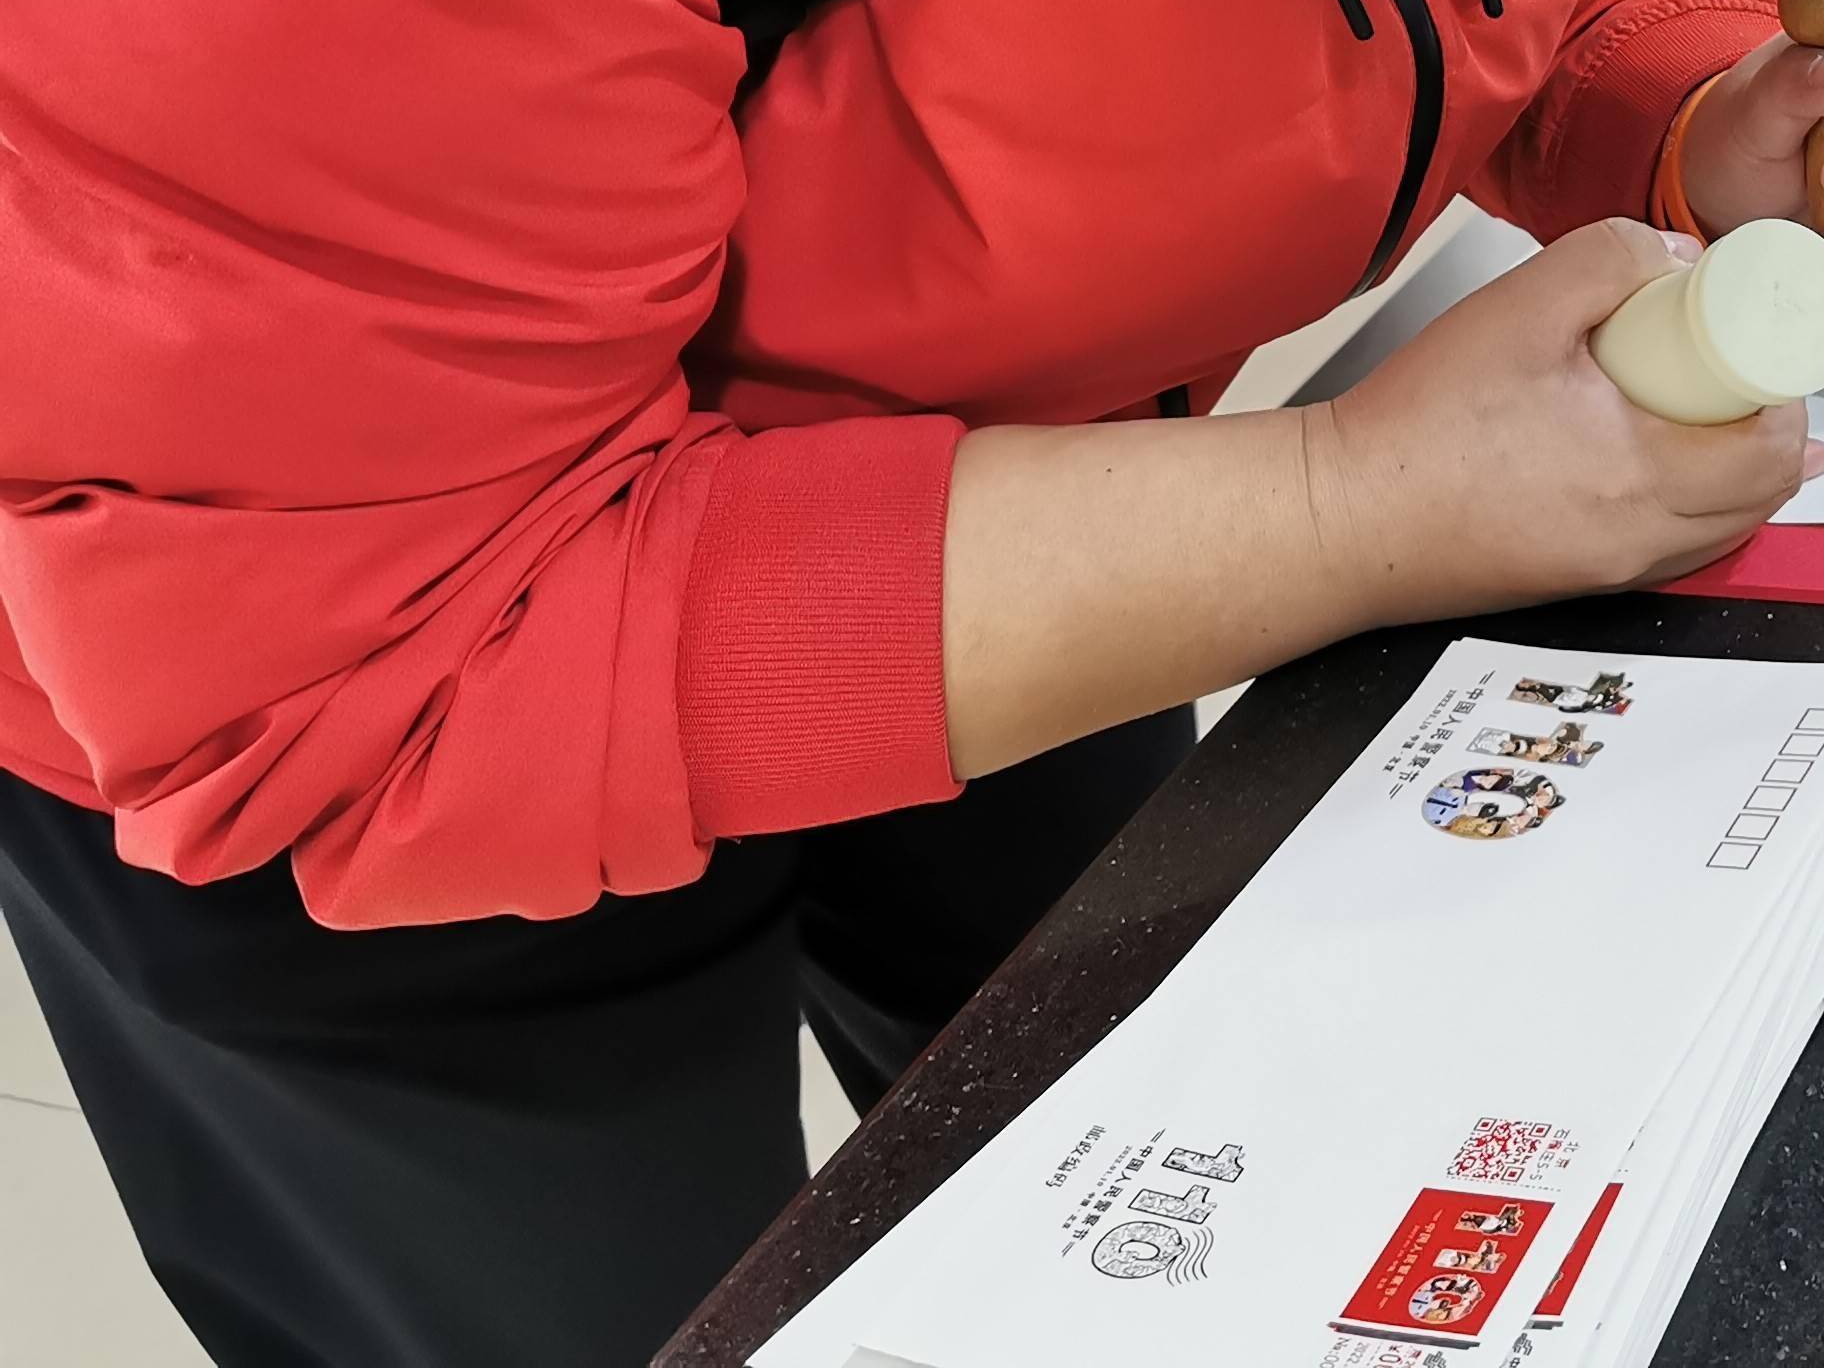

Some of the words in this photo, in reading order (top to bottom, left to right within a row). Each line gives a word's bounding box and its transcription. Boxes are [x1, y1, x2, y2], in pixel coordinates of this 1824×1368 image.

[1399, 686, 1485, 782] 中国人民警察节
[1045, 1124, 1106, 1188] 邮政编码
[1072, 1145, 1154, 1241] 中国人民警察节
